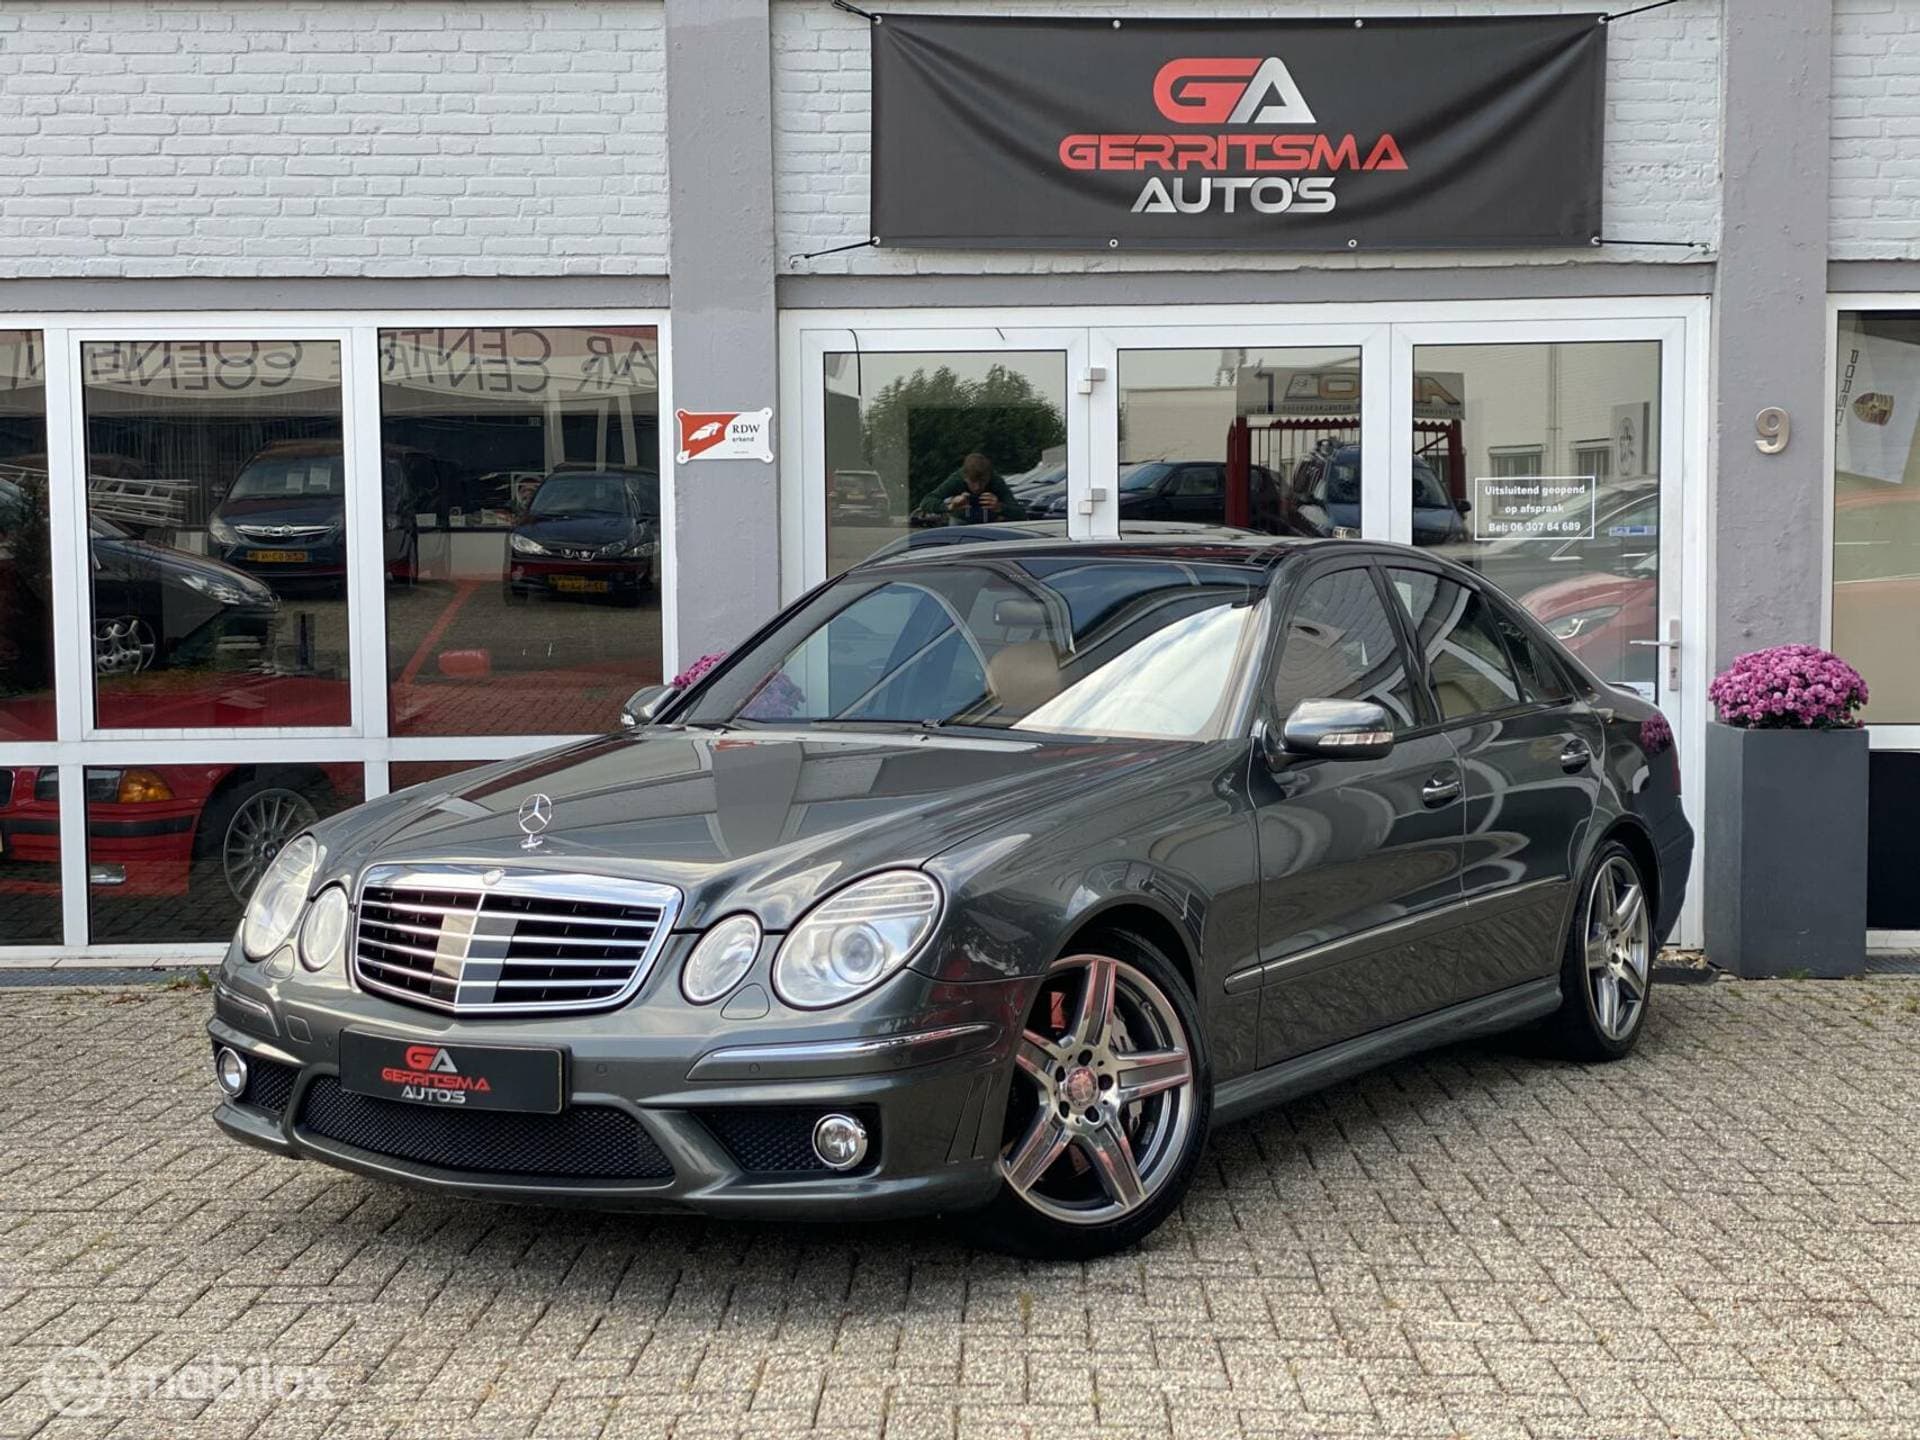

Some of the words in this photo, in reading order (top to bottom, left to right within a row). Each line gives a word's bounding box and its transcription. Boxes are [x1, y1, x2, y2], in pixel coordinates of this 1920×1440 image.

[1153, 57, 1317, 124] GA
[1058, 133, 1409, 170] GERRITSMA
[1130, 177, 1337, 213] AUTO'S
[732, 424, 760, 433] RDW
[1754, 406, 1790, 454] 9
[1484, 485, 1540, 495] Uitsluitend
[1542, 484, 1585, 497] geopend
[1505, 506, 1517, 515] op
[1520, 503, 1564, 515] afspraak
[1510, 522, 1522, 531] 06
[1562, 521, 1581, 531] 689
[406, 1045, 458, 1073] GA
[382, 1067, 491, 1091] GERRITSMA
[401, 1085, 466, 1104] AUTO'S
